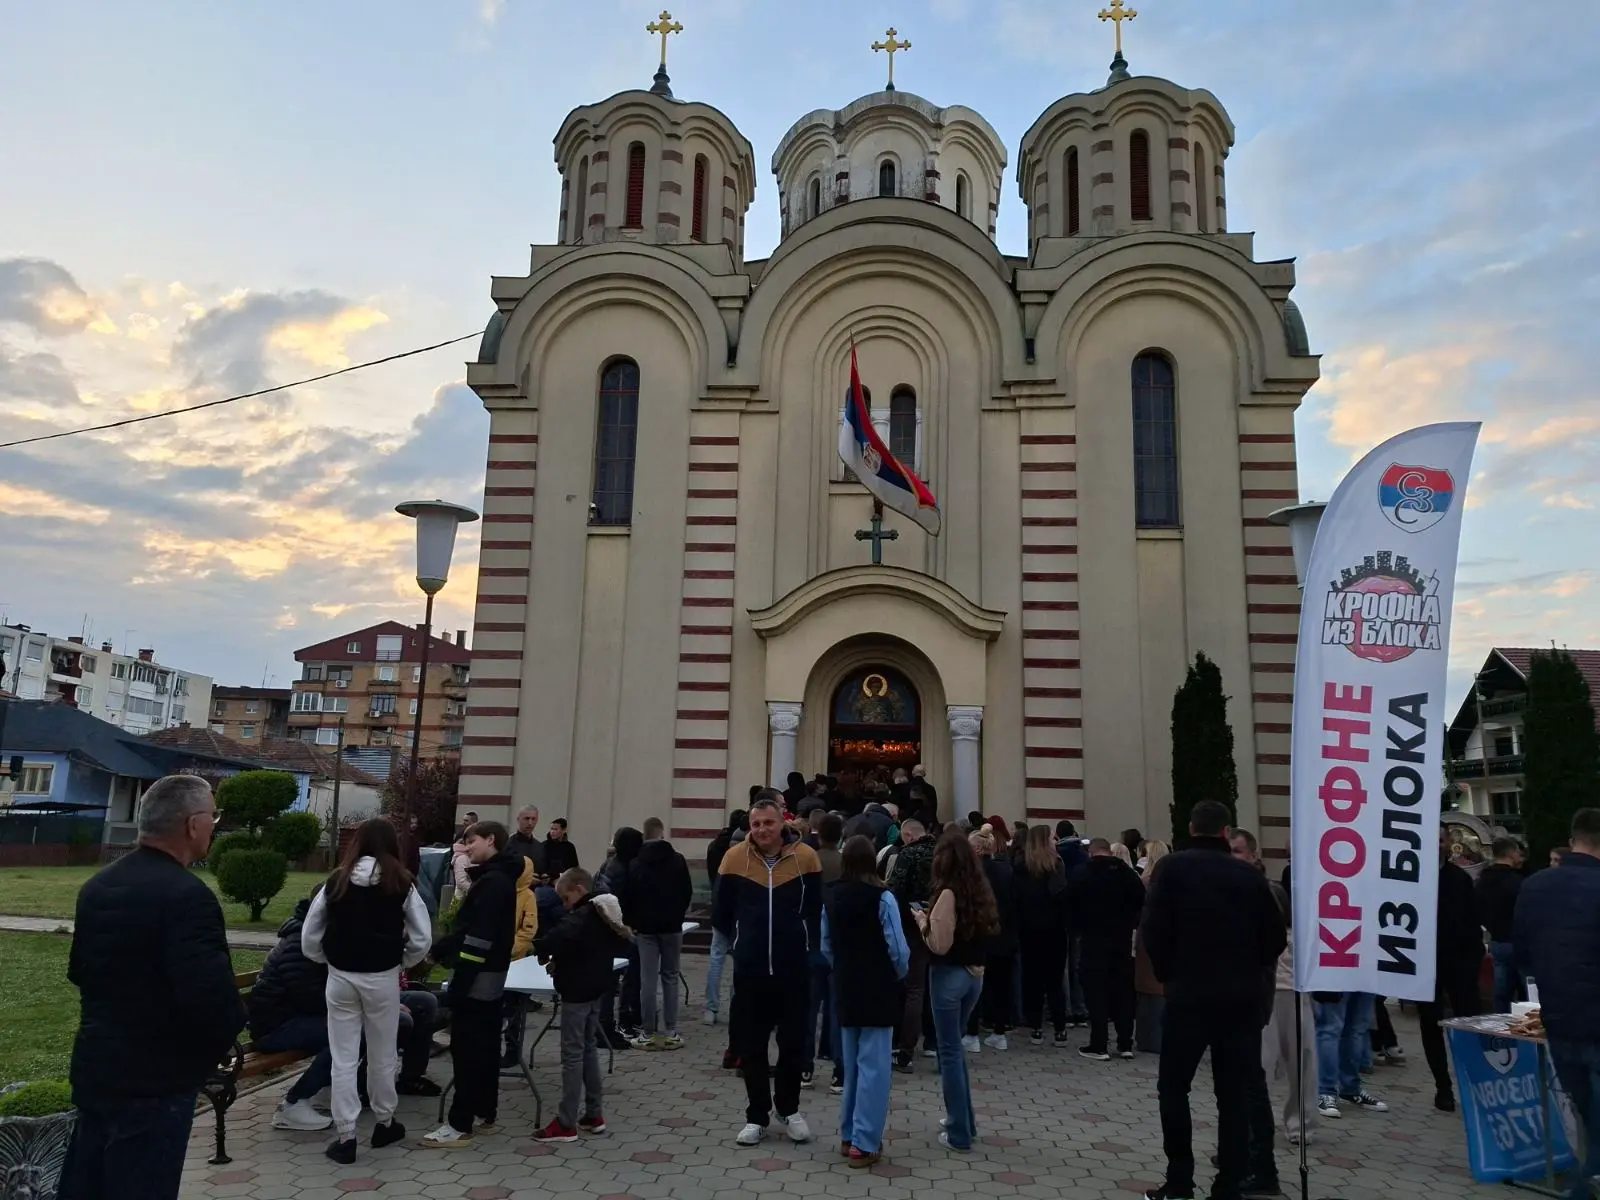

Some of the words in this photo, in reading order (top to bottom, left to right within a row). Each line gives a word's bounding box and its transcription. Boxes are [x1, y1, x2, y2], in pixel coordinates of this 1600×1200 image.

[1322, 619, 1356, 645] ИЗ
[1360, 620, 1441, 650] БЛОКА
[1325, 591, 1441, 624] КРОФНА
[1318, 681, 1373, 968] КРОФНЕ
[1380, 692, 1428, 883] БЛОКА
[1377, 901, 1419, 975] ИЗ
